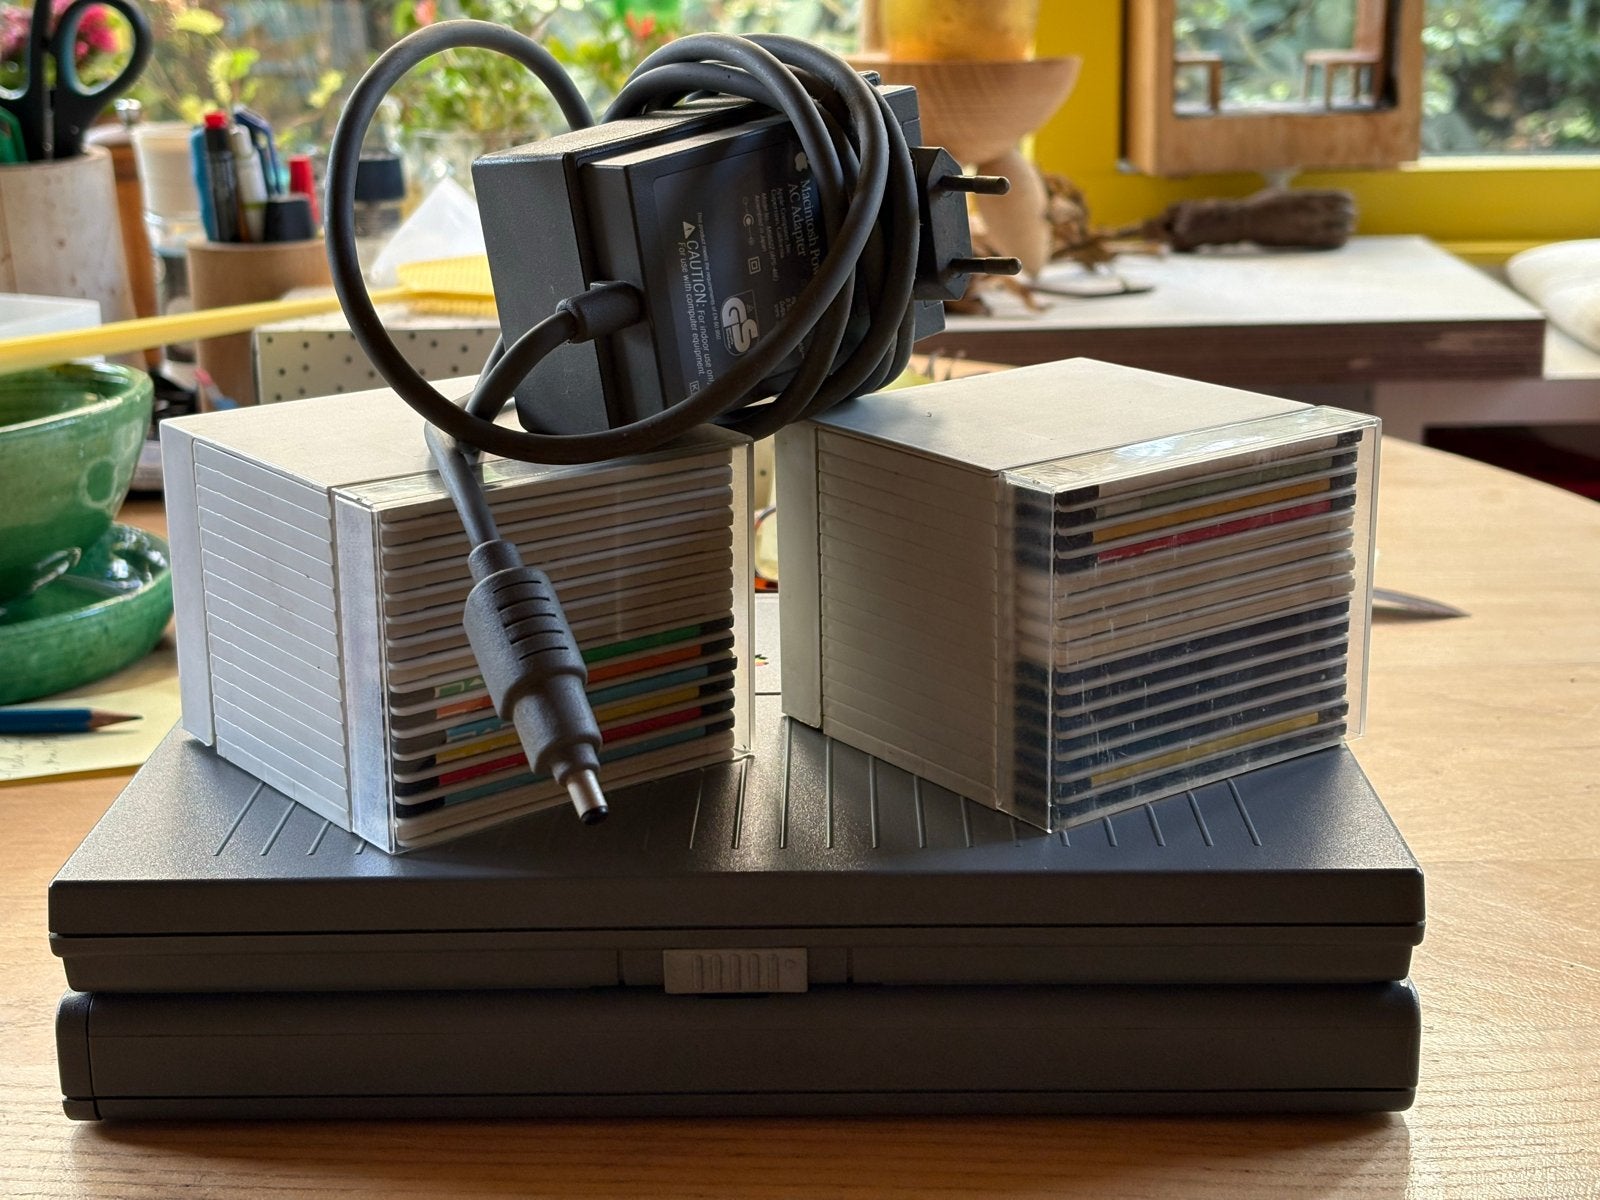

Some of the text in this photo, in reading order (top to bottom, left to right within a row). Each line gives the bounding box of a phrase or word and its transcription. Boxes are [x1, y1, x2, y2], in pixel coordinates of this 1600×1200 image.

[787, 183, 807, 256] AC Adapter
[800, 180, 819, 247] Macintosh
[678, 242, 686, 256] For
[683, 274, 692, 293] with
[686, 293, 698, 331] computer
[698, 310, 706, 325] For
[699, 326, 710, 351] indoor
